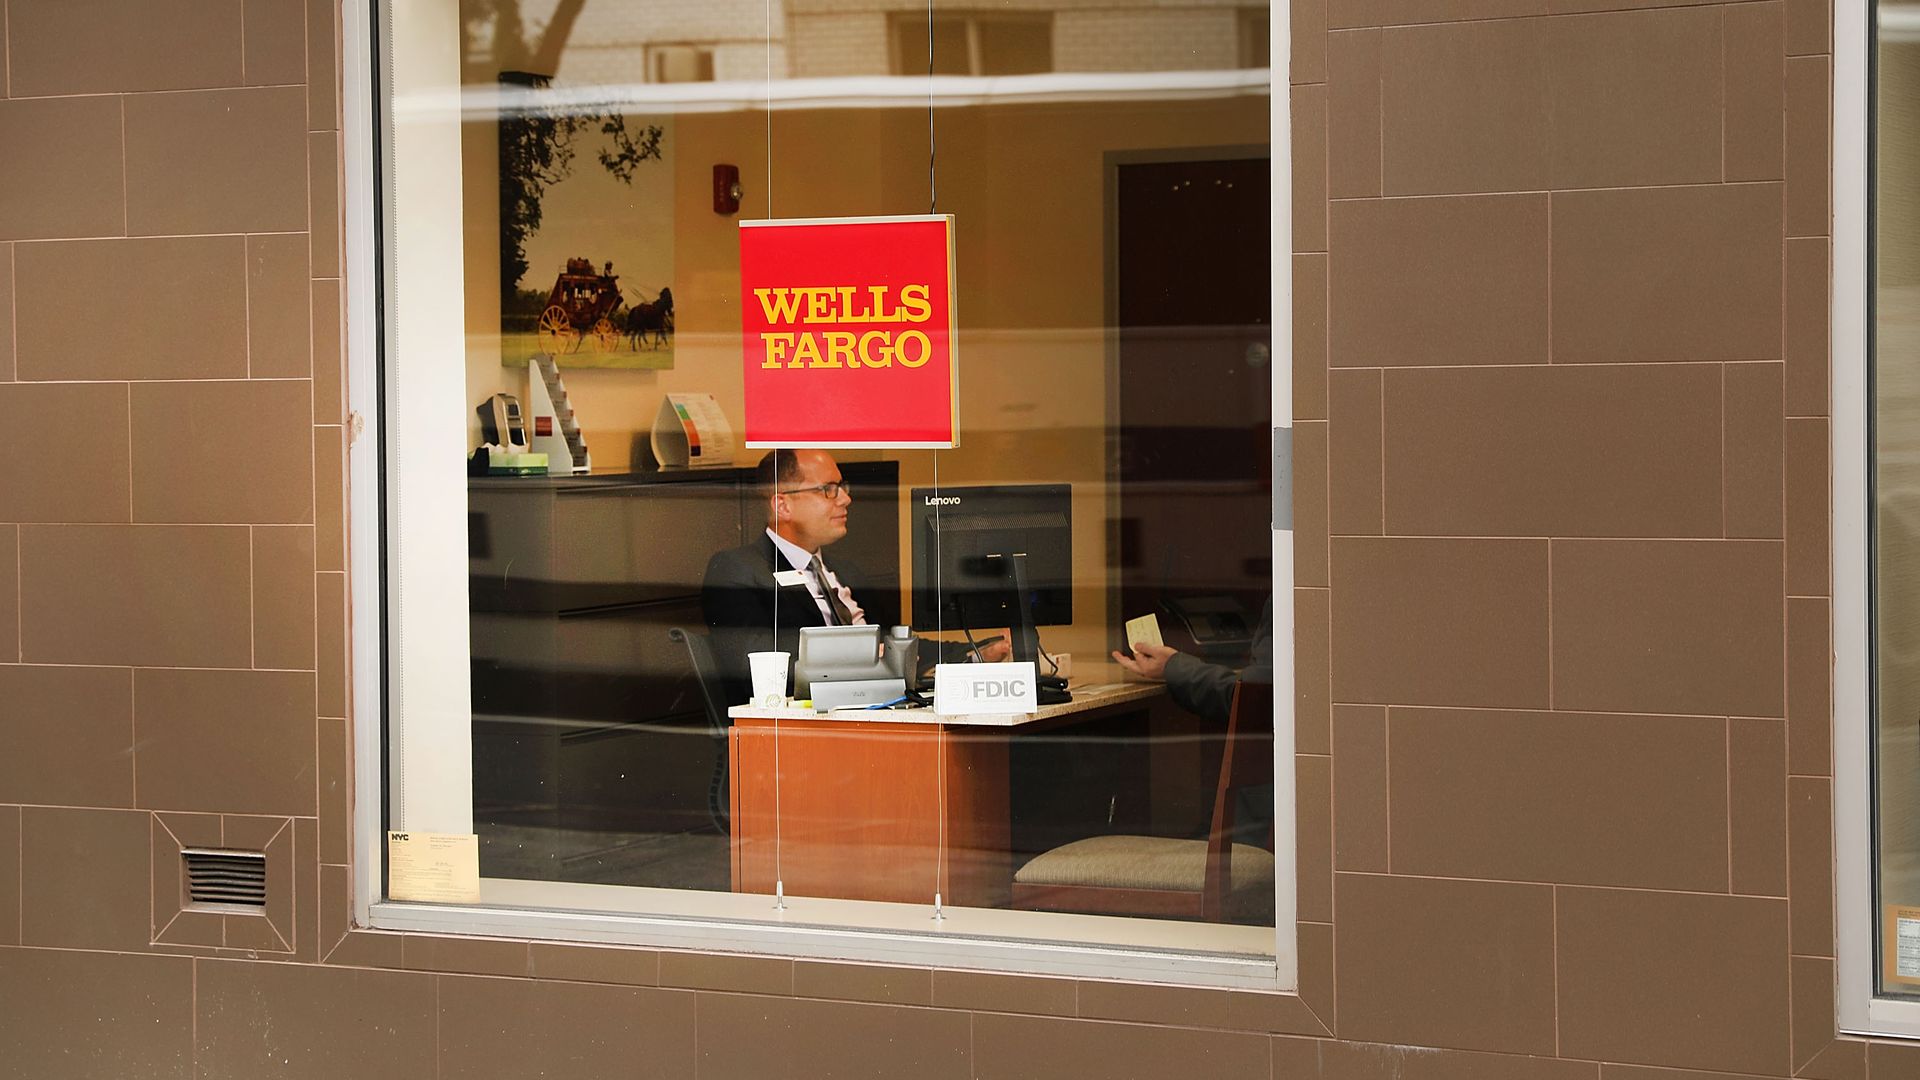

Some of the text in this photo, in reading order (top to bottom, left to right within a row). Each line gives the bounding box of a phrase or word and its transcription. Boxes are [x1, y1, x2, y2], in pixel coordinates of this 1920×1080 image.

[753, 284, 932, 325] WELLS
[760, 330, 932, 369] FARGO
[925, 495, 961, 506] Lenovo
[972, 680, 1026, 698] FDIC
[391, 833, 409, 841] NYC
